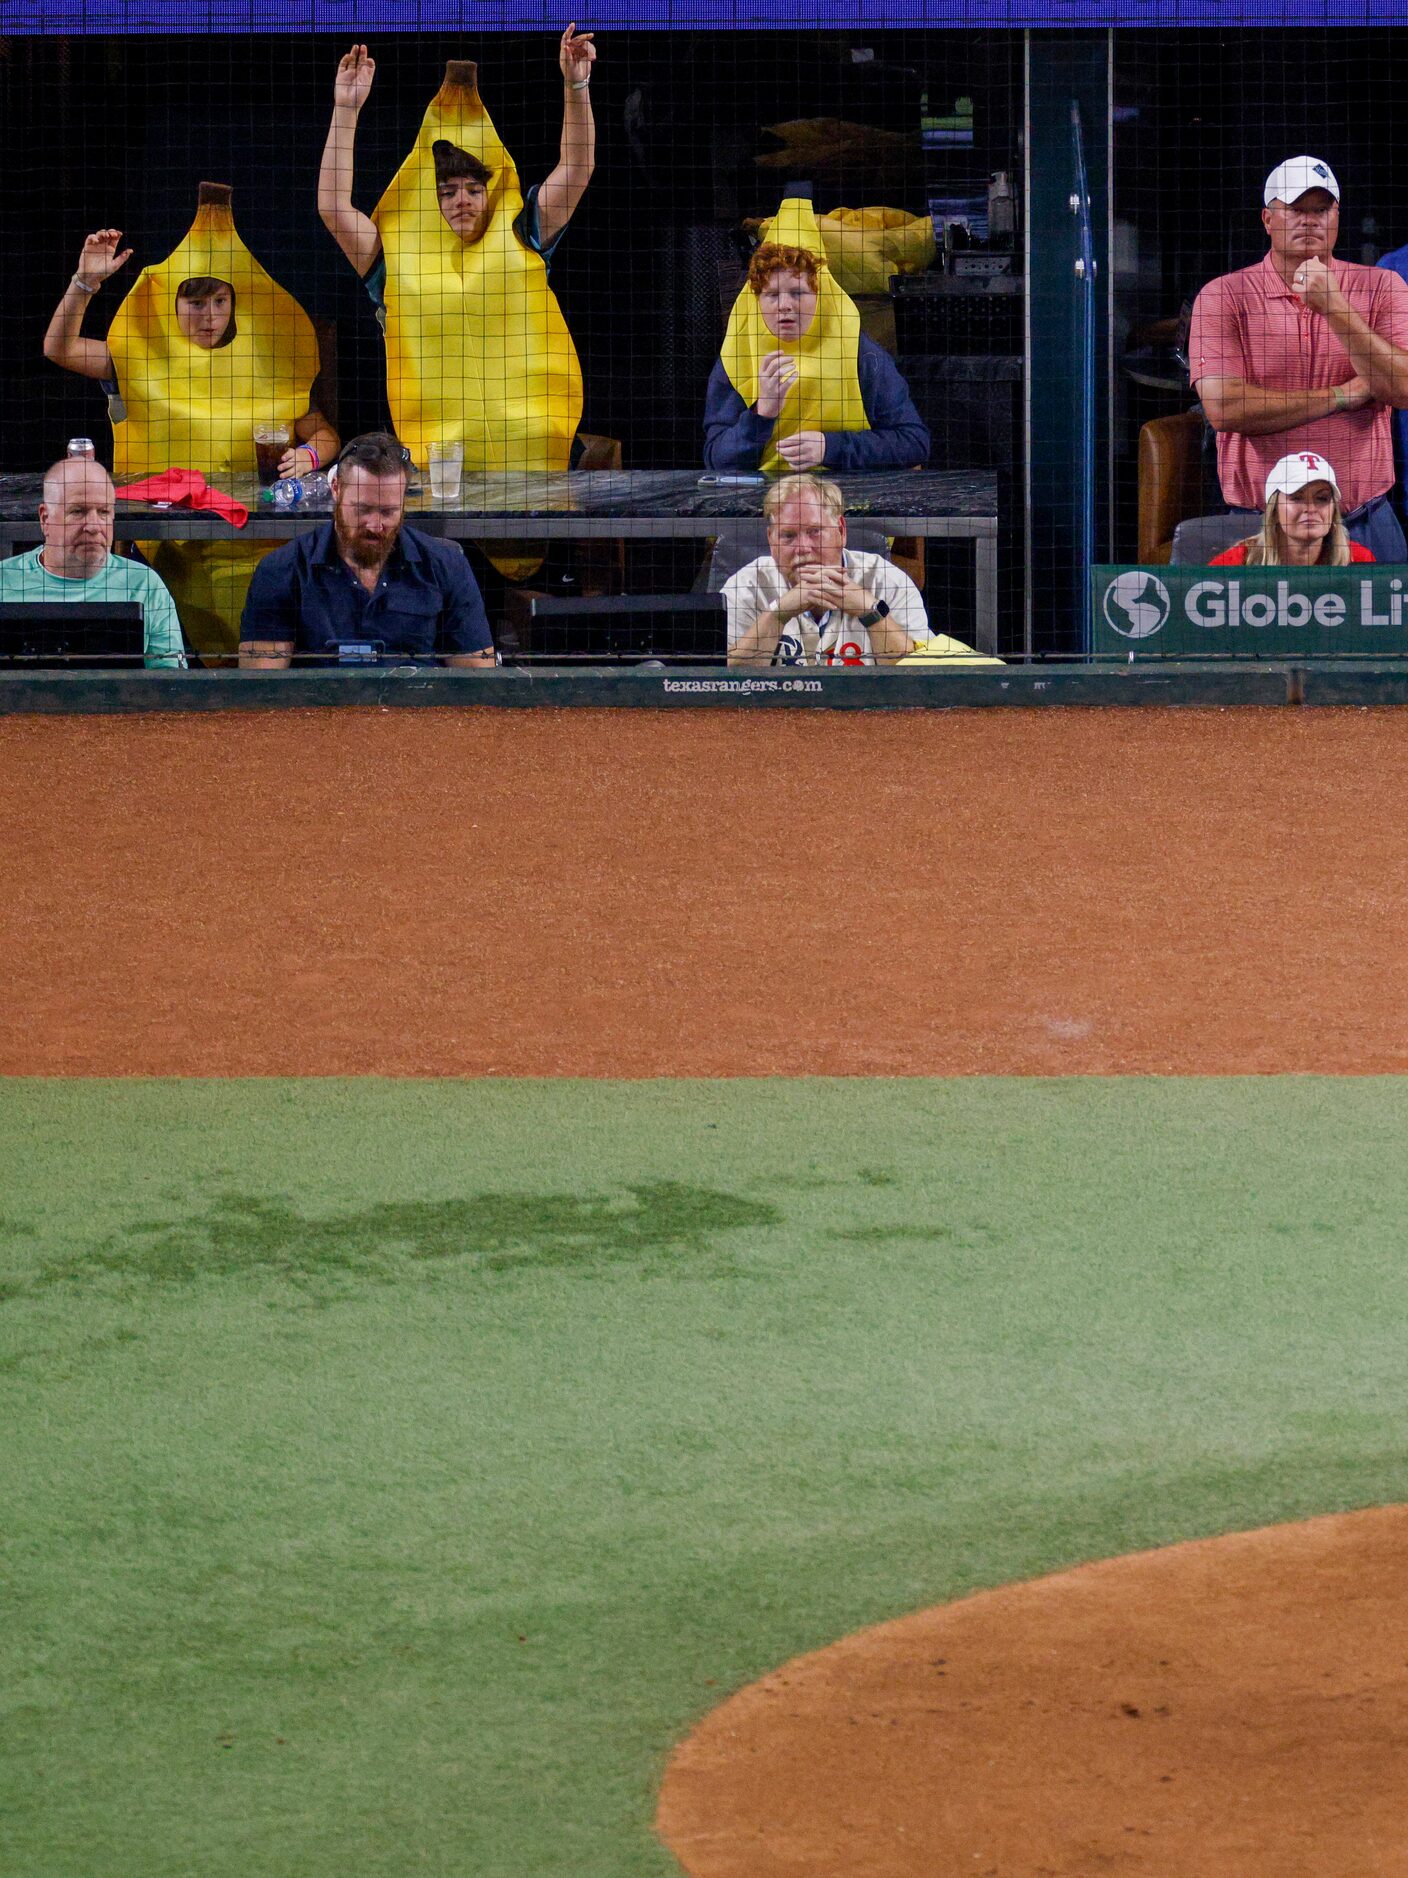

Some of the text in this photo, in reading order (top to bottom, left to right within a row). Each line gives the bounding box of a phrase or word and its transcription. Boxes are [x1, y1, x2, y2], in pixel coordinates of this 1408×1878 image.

[1299, 455, 1320, 471] T
[1184, 580, 1346, 628] Globe
[662, 678, 823, 696] texasrangers.com
